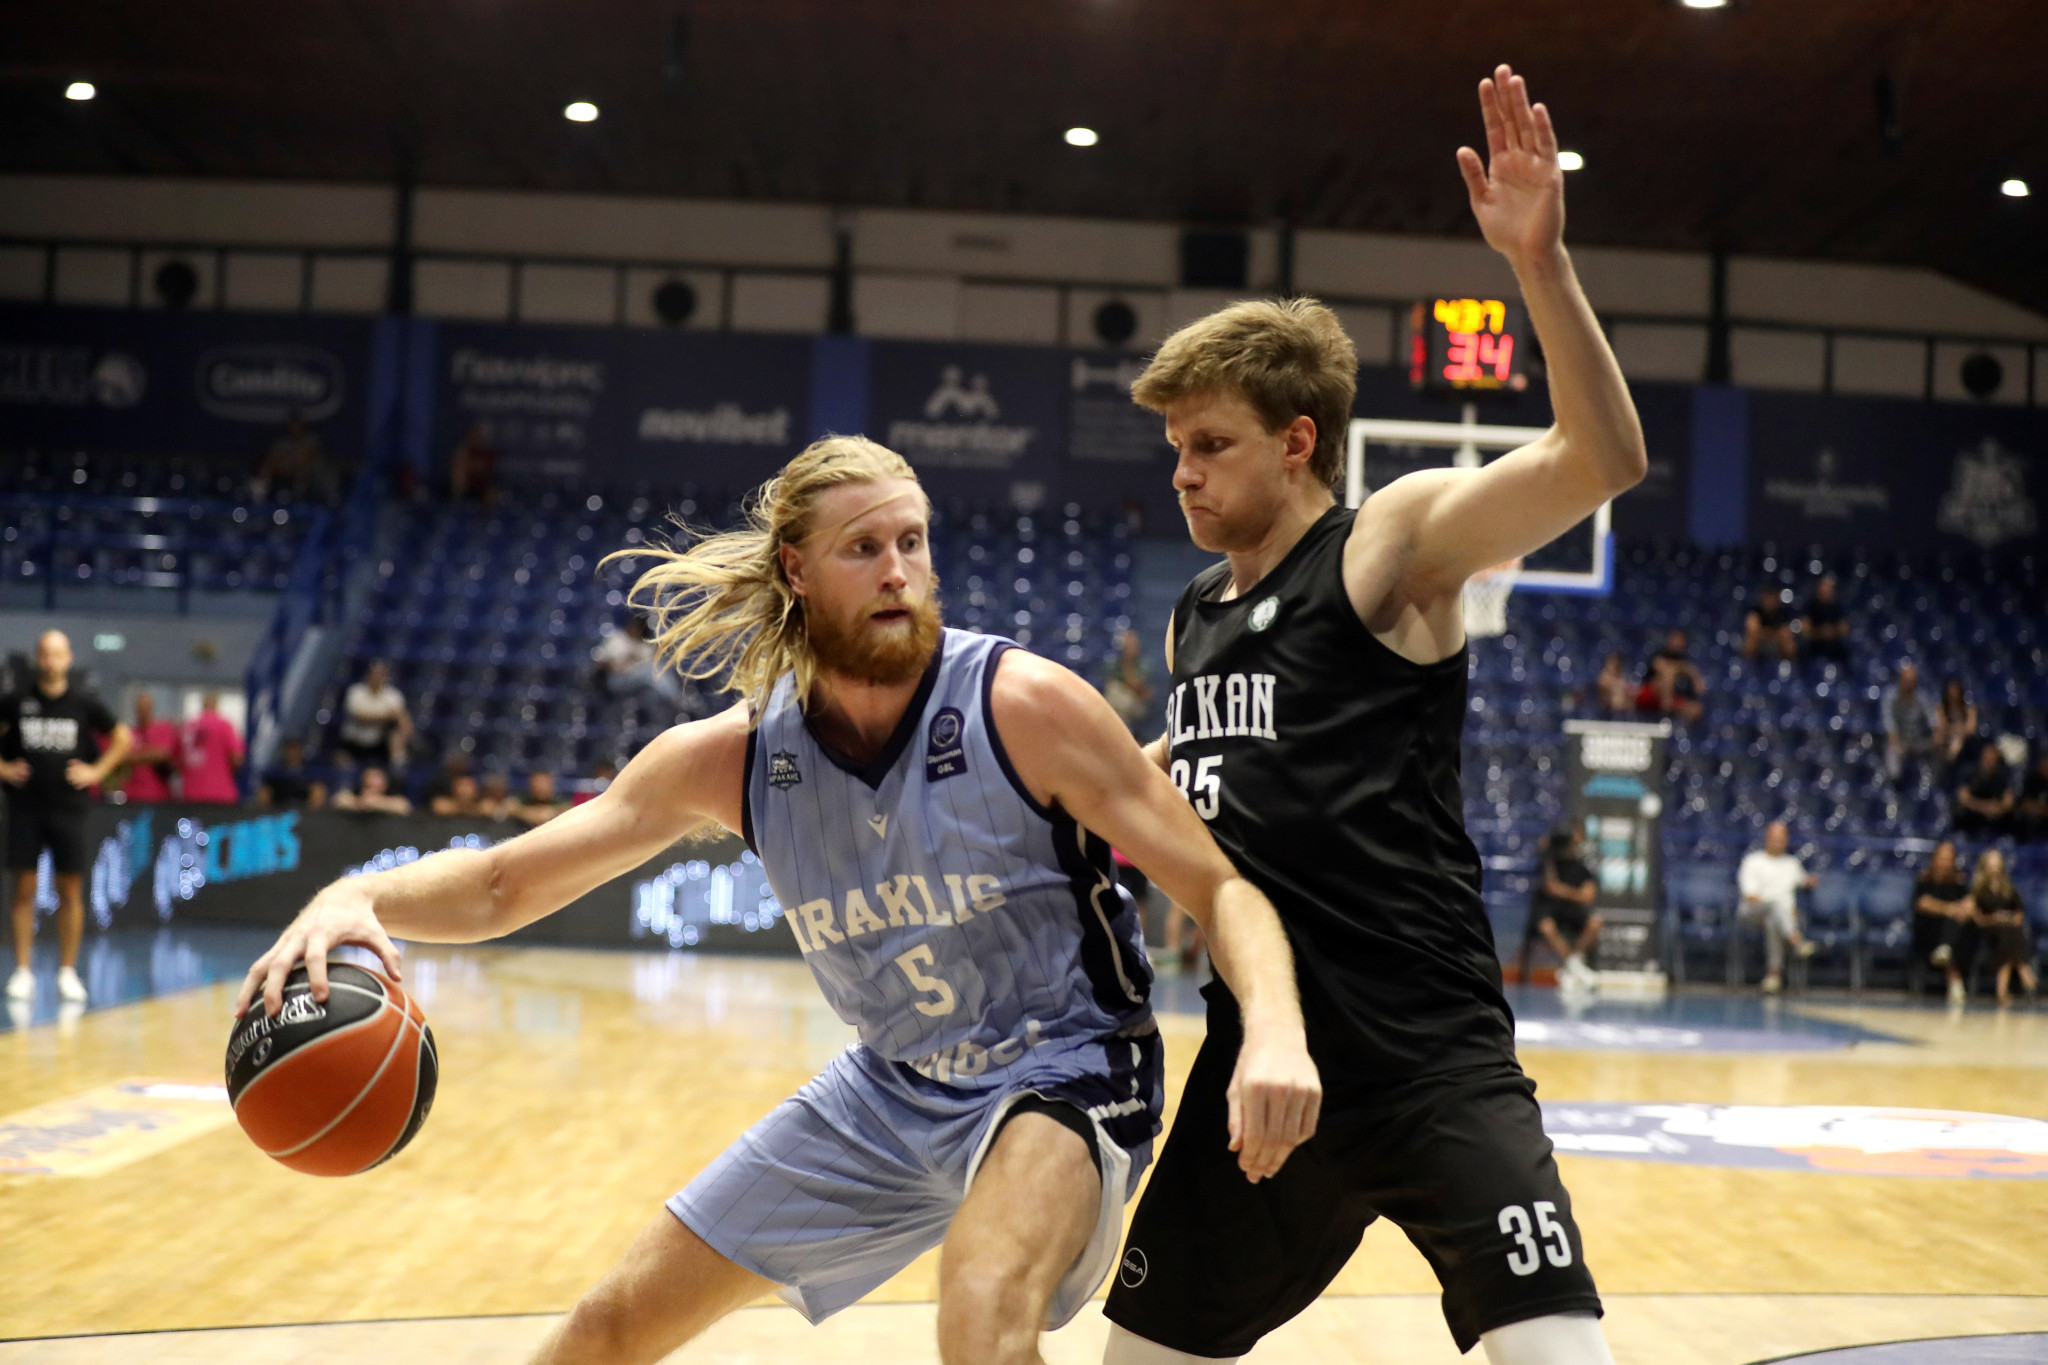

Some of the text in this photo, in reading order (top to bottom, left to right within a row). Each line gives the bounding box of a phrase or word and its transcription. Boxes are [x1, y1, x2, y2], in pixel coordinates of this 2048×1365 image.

[1443, 332, 1514, 381] 34
[1165, 673, 1277, 750] ALKAN
[894, 944, 955, 1018] 5
[1498, 1201, 1572, 1276] 35
